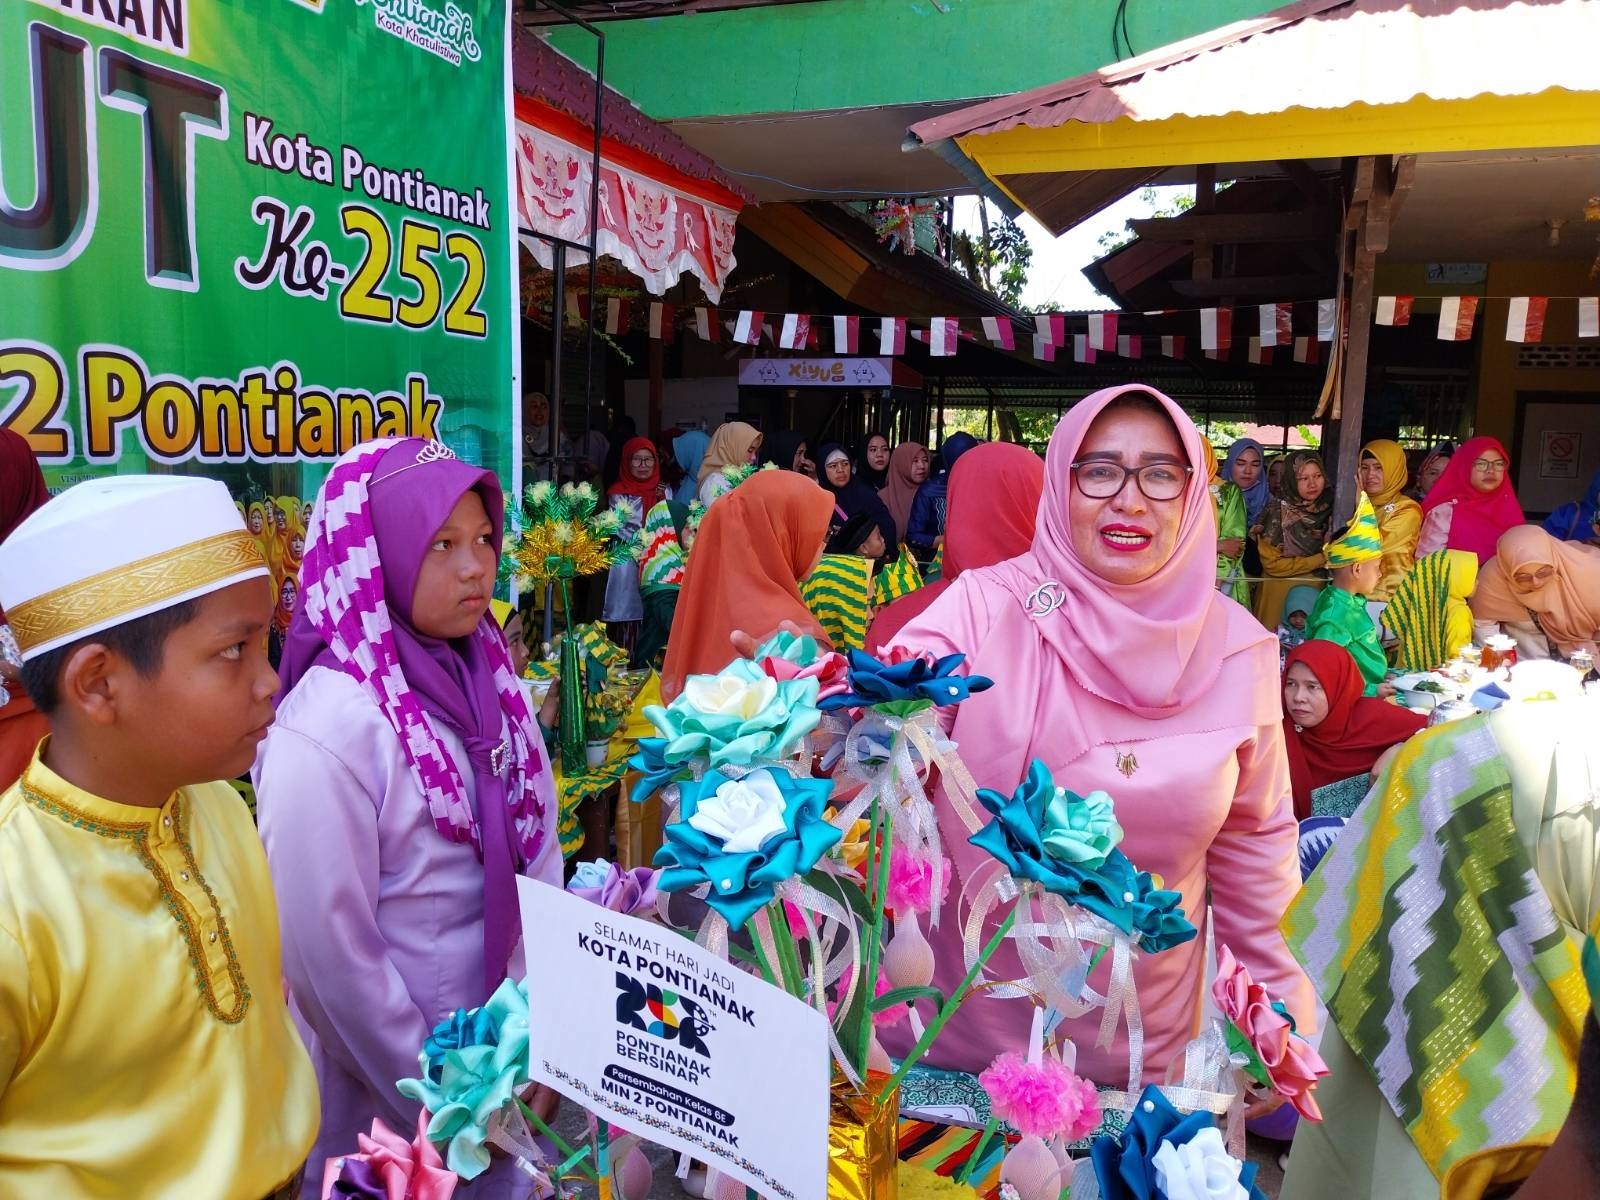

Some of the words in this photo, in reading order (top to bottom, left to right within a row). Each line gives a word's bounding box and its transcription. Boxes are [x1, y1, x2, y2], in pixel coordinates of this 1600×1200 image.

[377, 13, 402, 35] Kota
[405, 27, 460, 64] Khatulistiwa
[244, 112, 334, 187] Kota
[341, 144, 491, 230] Pontianak
[82, 364, 443, 458] Pontianak
[578, 932, 631, 968] KOTA
[636, 955, 756, 1027] PONTIANAK
[594, 922, 661, 953] SELAMAT
[666, 947, 699, 974] HARI
[703, 967, 735, 994] JADI
[616, 1030, 711, 1079] PONTIANAK
[616, 1043, 699, 1086] BERSINAR
[601, 1077, 630, 1101] MIN
[633, 1091, 642, 1105] 2
[645, 1096, 740, 1149] PONTIANAK
[612, 1067, 683, 1104] Persembahan
[684, 1096, 712, 1117] Kelas
[714, 1110, 727, 1123] 6E
